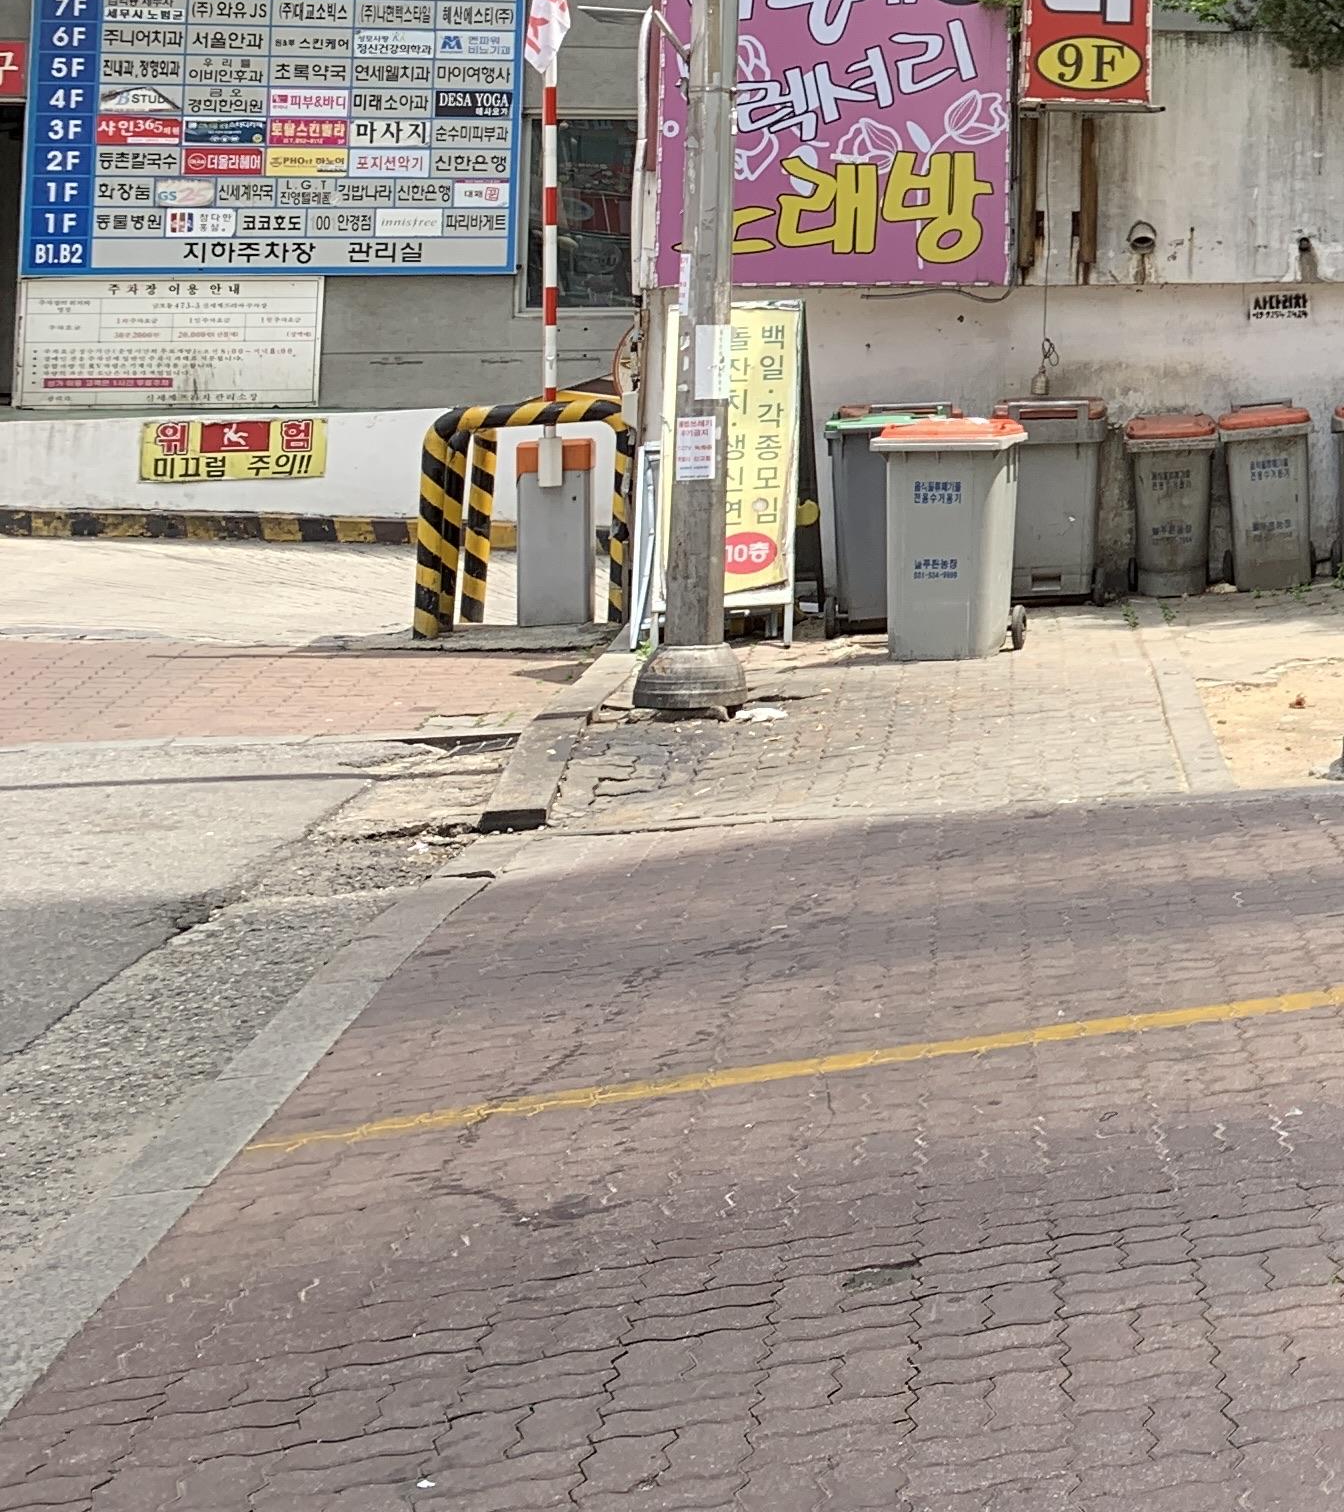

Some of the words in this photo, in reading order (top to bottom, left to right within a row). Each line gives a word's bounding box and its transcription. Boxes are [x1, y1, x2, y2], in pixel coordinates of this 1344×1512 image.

[52, 27, 87, 46] 6F
[104, 29, 183, 48] 주니어치과
[192, 31, 264, 50] 서울안과
[299, 38, 349, 50] 스킨케어
[356, 43, 432, 55] 정신건강의학과
[51, 58, 85, 78] 5F
[189, 68, 264, 83] 이비인후과
[275, 63, 347, 81] 초록약국
[355, 66, 430, 82] 연세웰치과
[437, 66, 510, 84] 마이여행사
[1057, 43, 1125, 82] 9F
[49, 88, 84, 109] 4F
[189, 99, 264, 113] 경희한의원
[290, 95, 346, 110] 피부&바디
[353, 94, 429, 111] 미래소아과
[439, 93, 472, 107] DESA
[476, 93, 509, 107] YOGA
[48, 119, 82, 140] 3F
[97, 118, 163, 136] 샤인365
[356, 120, 427, 144] 마사지
[436, 125, 508, 142] 순수미피부과
[46, 151, 80, 171] 2F
[99, 151, 178, 170] 등촌칼국수
[356, 156, 424, 170] 포지션악기
[435, 154, 507, 172] 신한은행
[46, 182, 79, 202] 1F
[219, 184, 273, 202] 신세계약국
[338, 185, 392, 200] 김밥나라
[398, 185, 450, 202] 신한은행
[45, 213, 77, 233] 1F
[97, 215, 161, 231] 동물병원
[243, 215, 300, 230] 코코호도
[338, 214, 371, 231] 안경점
[446, 214, 506, 231] 파리바게트
[35, 243, 82, 264] B1.B2
[183, 241, 316, 264] 지하주차장
[348, 241, 423, 263] 관리실
[156, 421, 190, 456] 위
[282, 419, 314, 453] 험
[153, 457, 226, 479] 미끄럼
[247, 454, 312, 478] 주의!!
